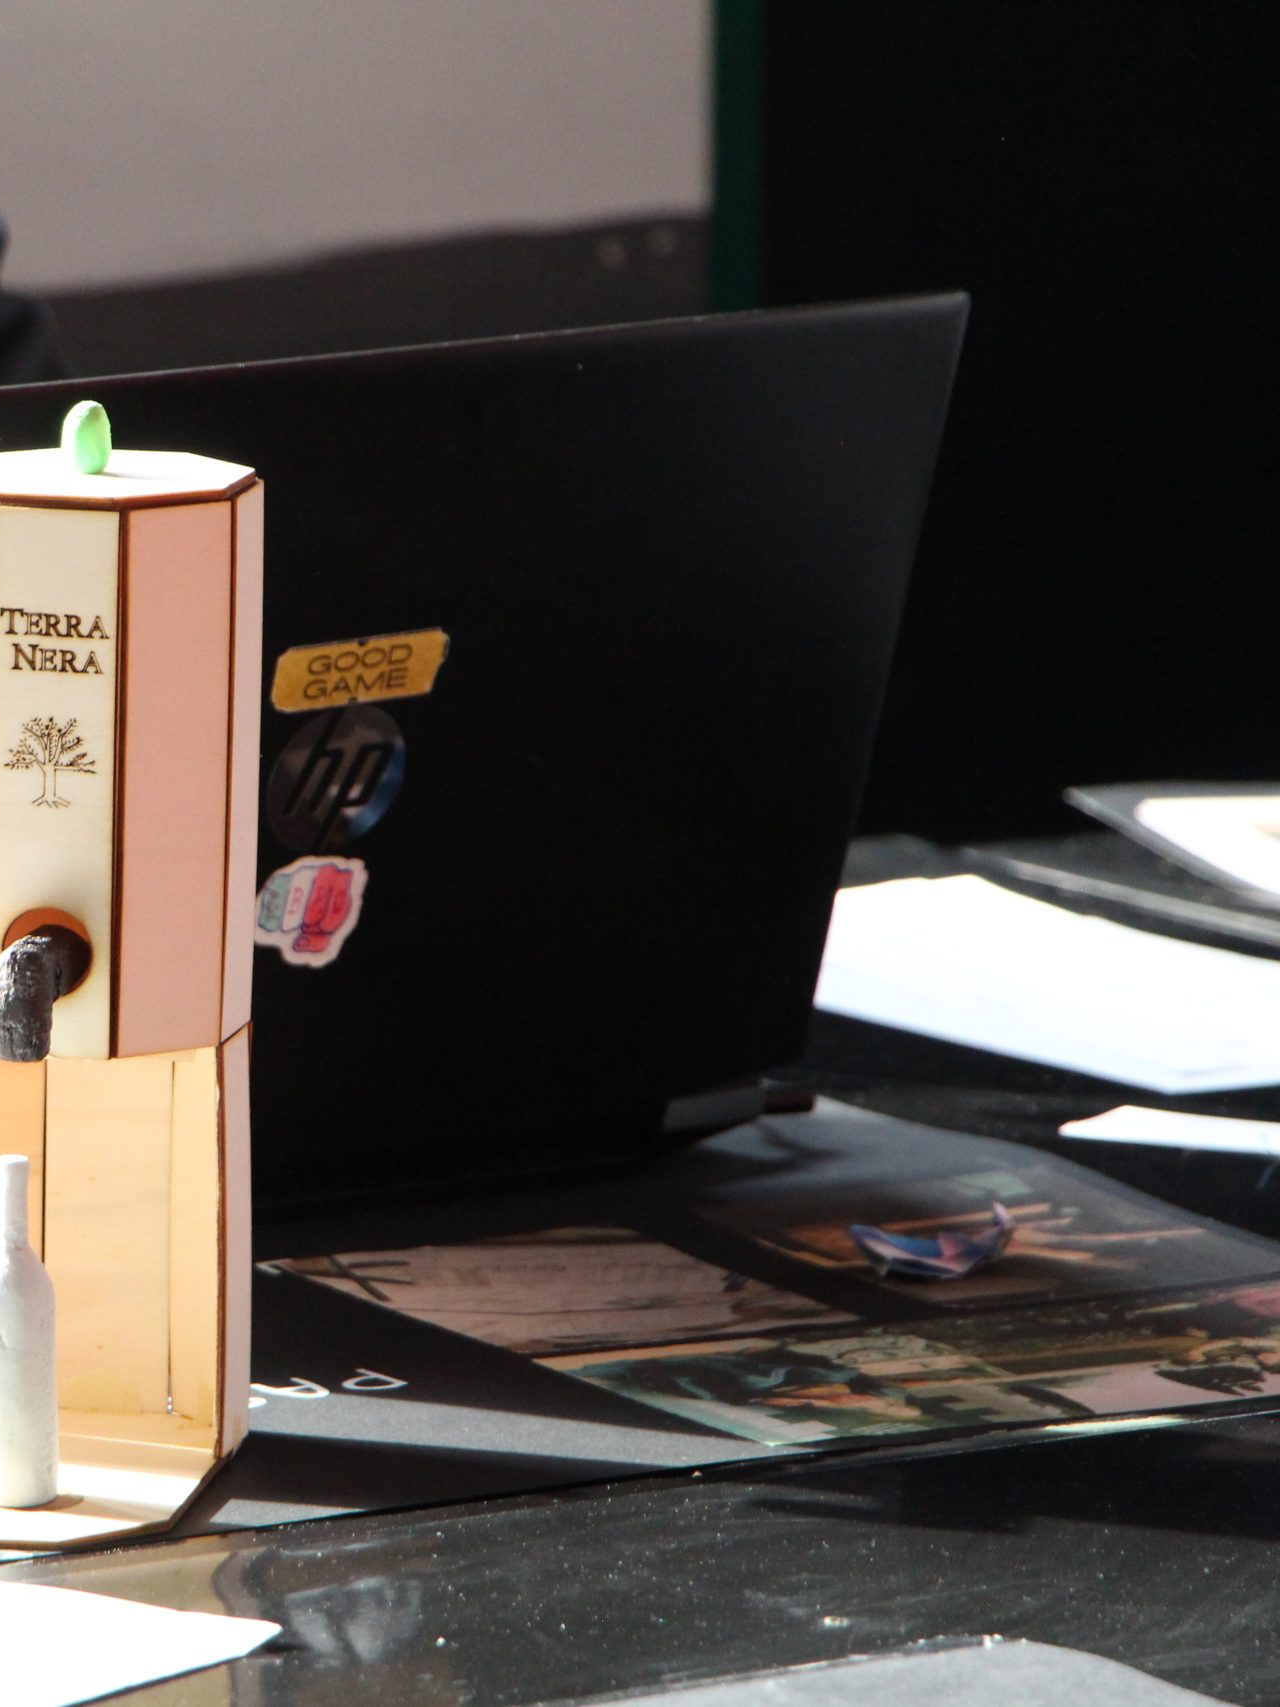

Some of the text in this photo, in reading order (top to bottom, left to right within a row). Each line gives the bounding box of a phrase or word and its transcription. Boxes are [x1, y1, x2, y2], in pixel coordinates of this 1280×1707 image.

[0, 607, 110, 640] TERRA
[11, 643, 104, 675] NERA
[307, 644, 414, 676] GOOD
[303, 667, 409, 701] GAME
[283, 704, 397, 849] hp
